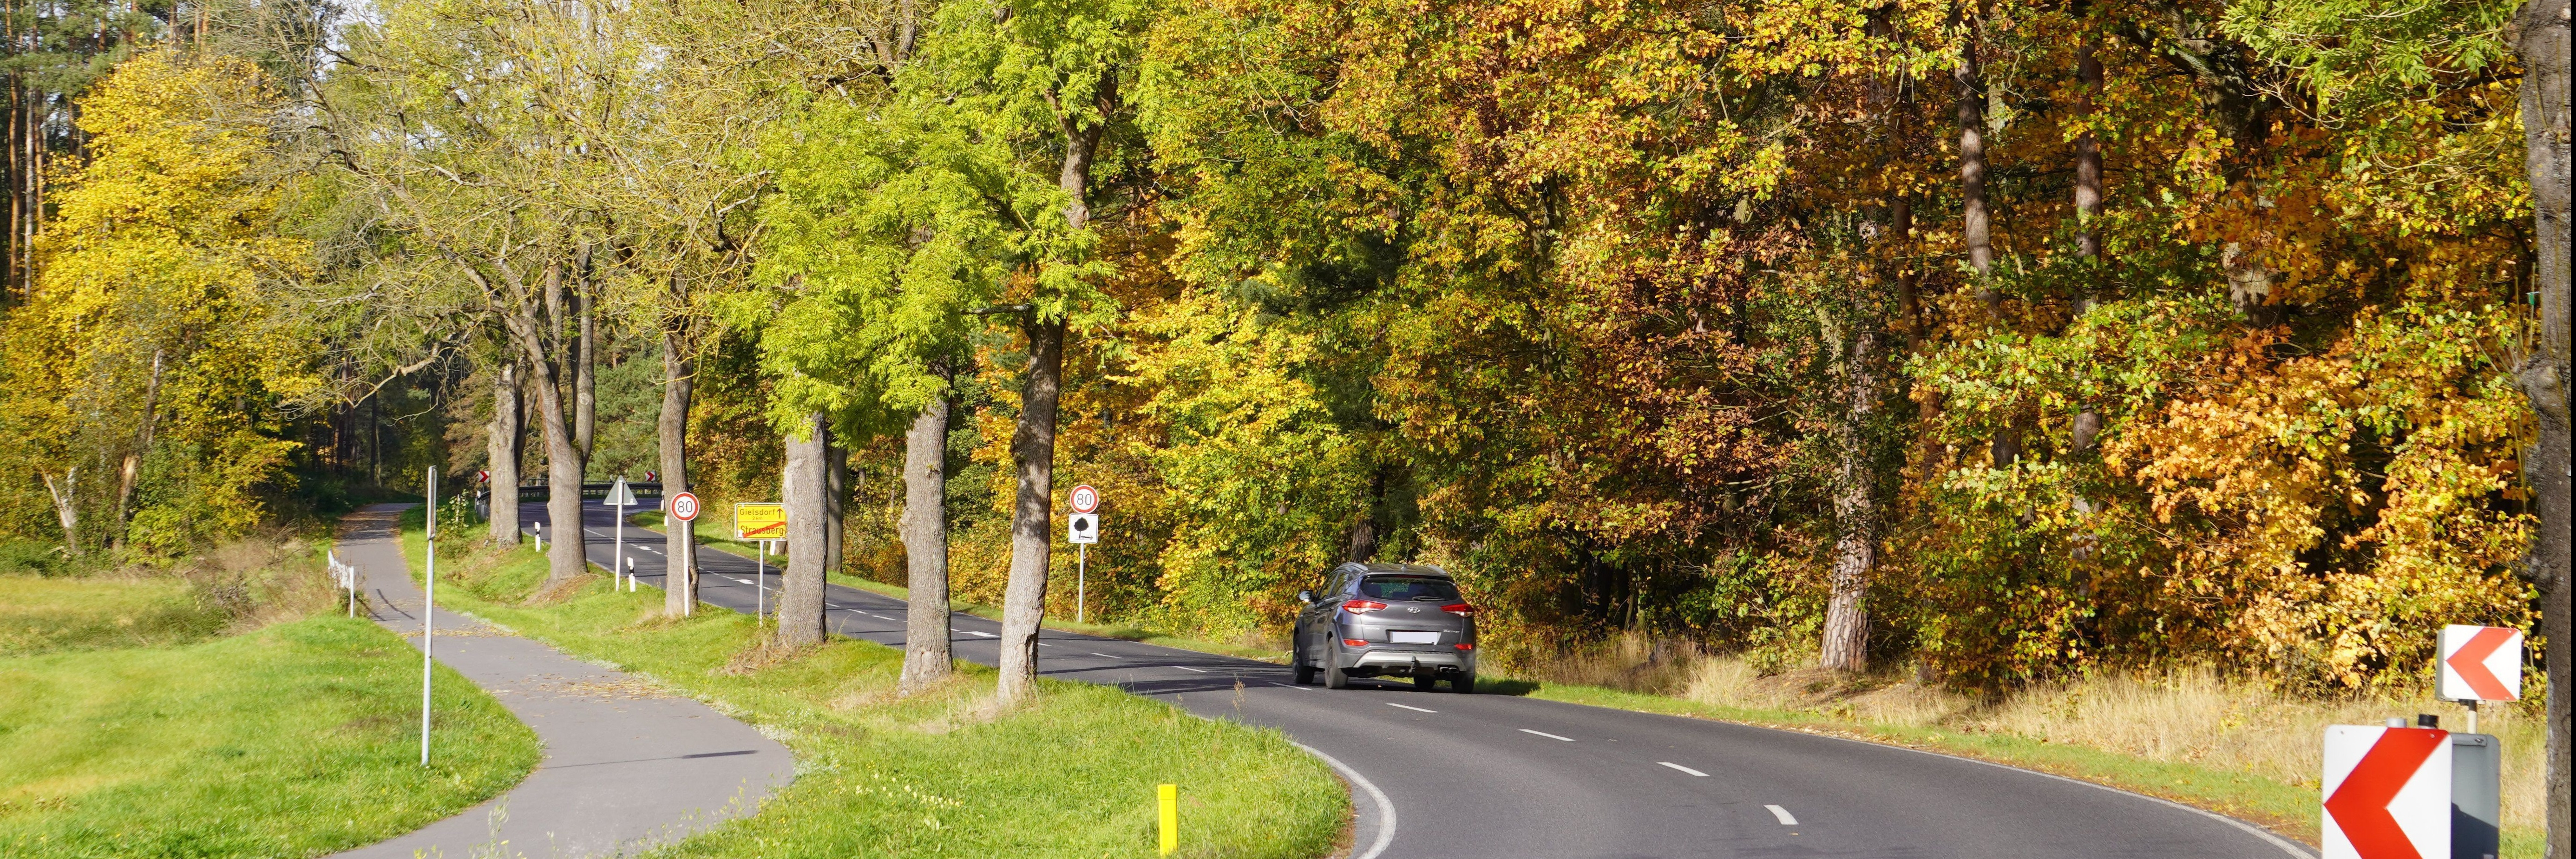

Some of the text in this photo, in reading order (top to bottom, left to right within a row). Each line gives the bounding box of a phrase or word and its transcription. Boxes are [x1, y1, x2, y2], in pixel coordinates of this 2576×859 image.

[1077, 493, 1092, 505] 80
[678, 501, 693, 513] 80
[741, 525, 784, 537] Strausberg
